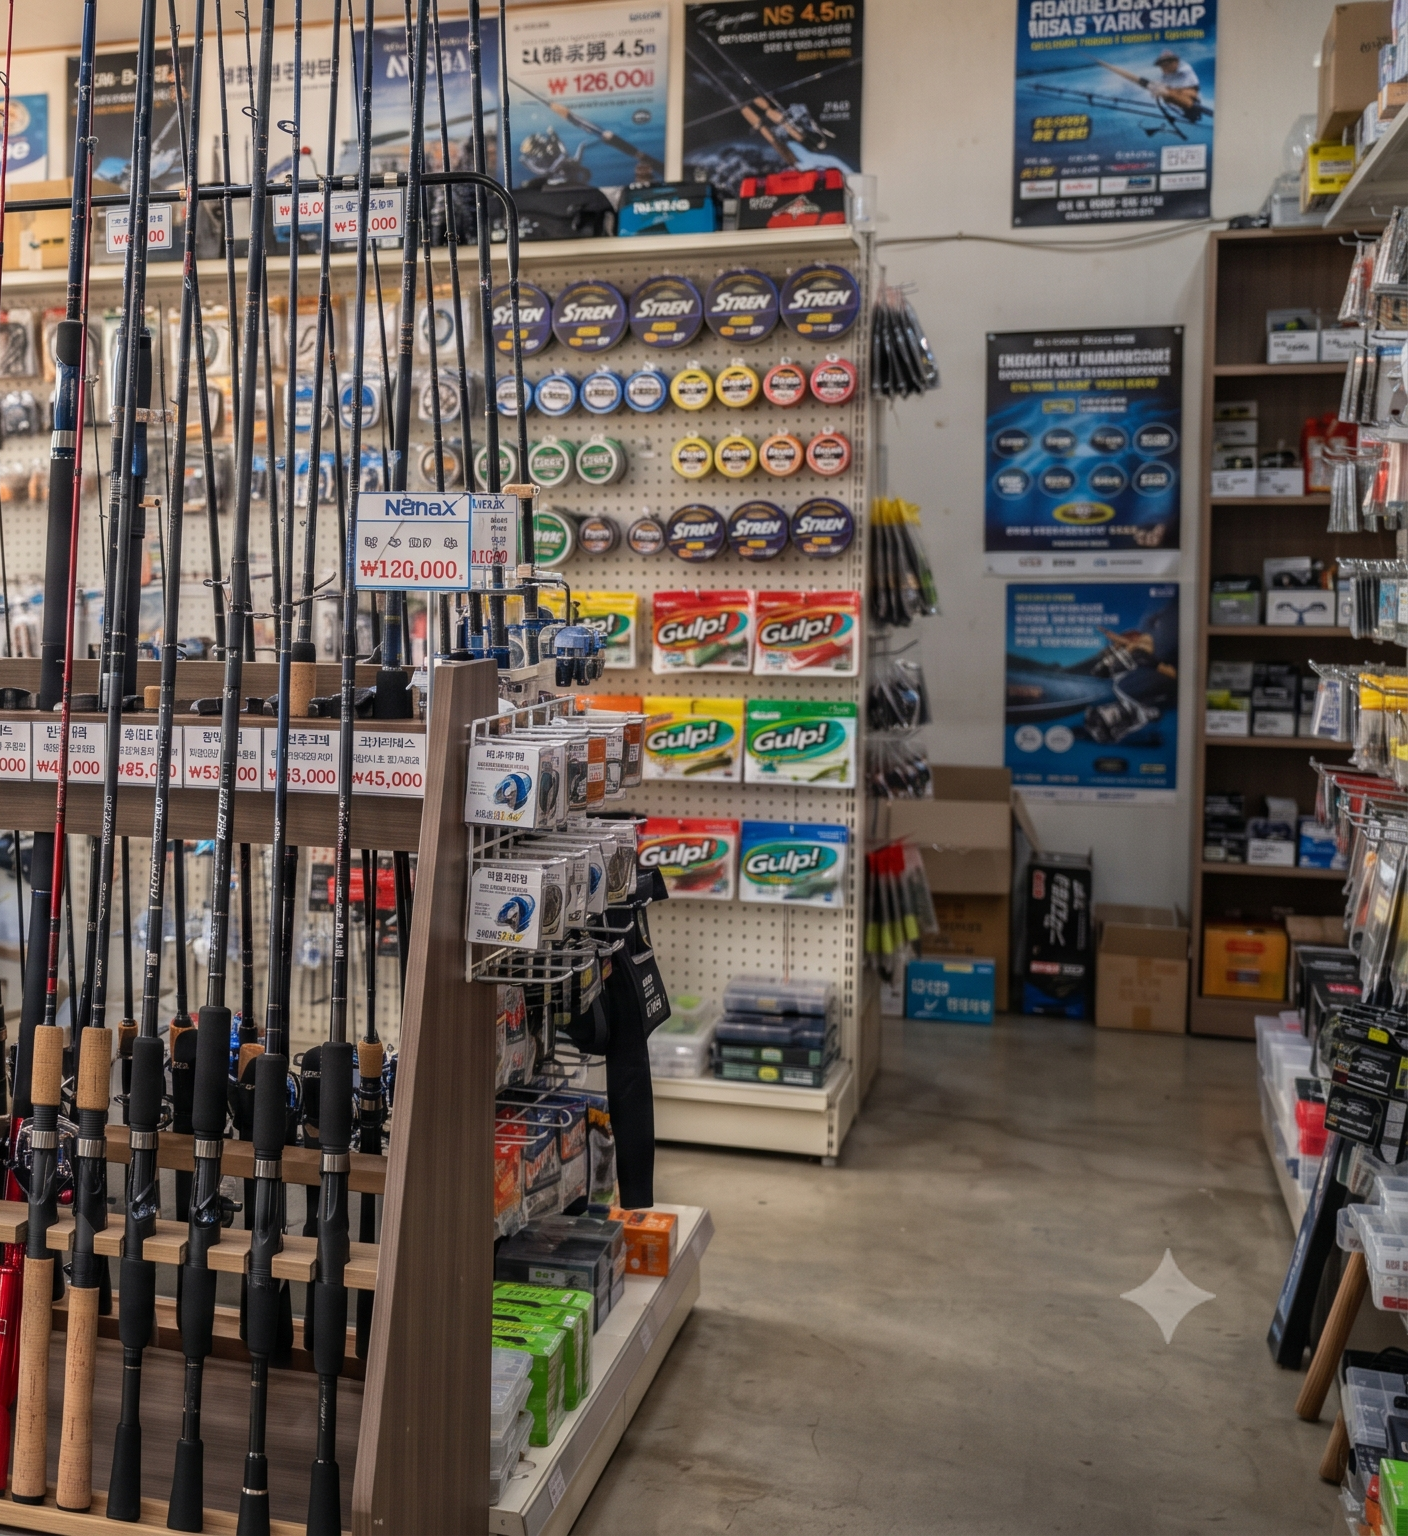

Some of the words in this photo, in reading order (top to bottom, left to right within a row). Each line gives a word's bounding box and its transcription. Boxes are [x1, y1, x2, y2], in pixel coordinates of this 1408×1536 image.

[763, 5, 795, 26] NS
[800, 2, 855, 23] 4.5m
[1092, 12, 1144, 34] YARK
[1149, 5, 1206, 29] SHAP
[335, 216, 397, 233] ₩5,000
[635, 298, 694, 319] STREN
[711, 292, 771, 313] STREN
[788, 288, 851, 310] STREN
[559, 303, 617, 324] STREN
[670, 521, 719, 540] STREN
[732, 519, 782, 538] STREN
[796, 516, 847, 534] STREN
[657, 612, 730, 645] Gulp!
[760, 614, 833, 645] Gulp!
[647, 721, 718, 750] Gulp!
[753, 722, 828, 751] Gulp!
[37, 760, 100, 776] ₩4,000
[189, 765, 257, 781] ₩5300
[352, 770, 422, 788] ₩45,000
[639, 840, 710, 867] Gulp!
[746, 847, 820, 875] Gulp!
